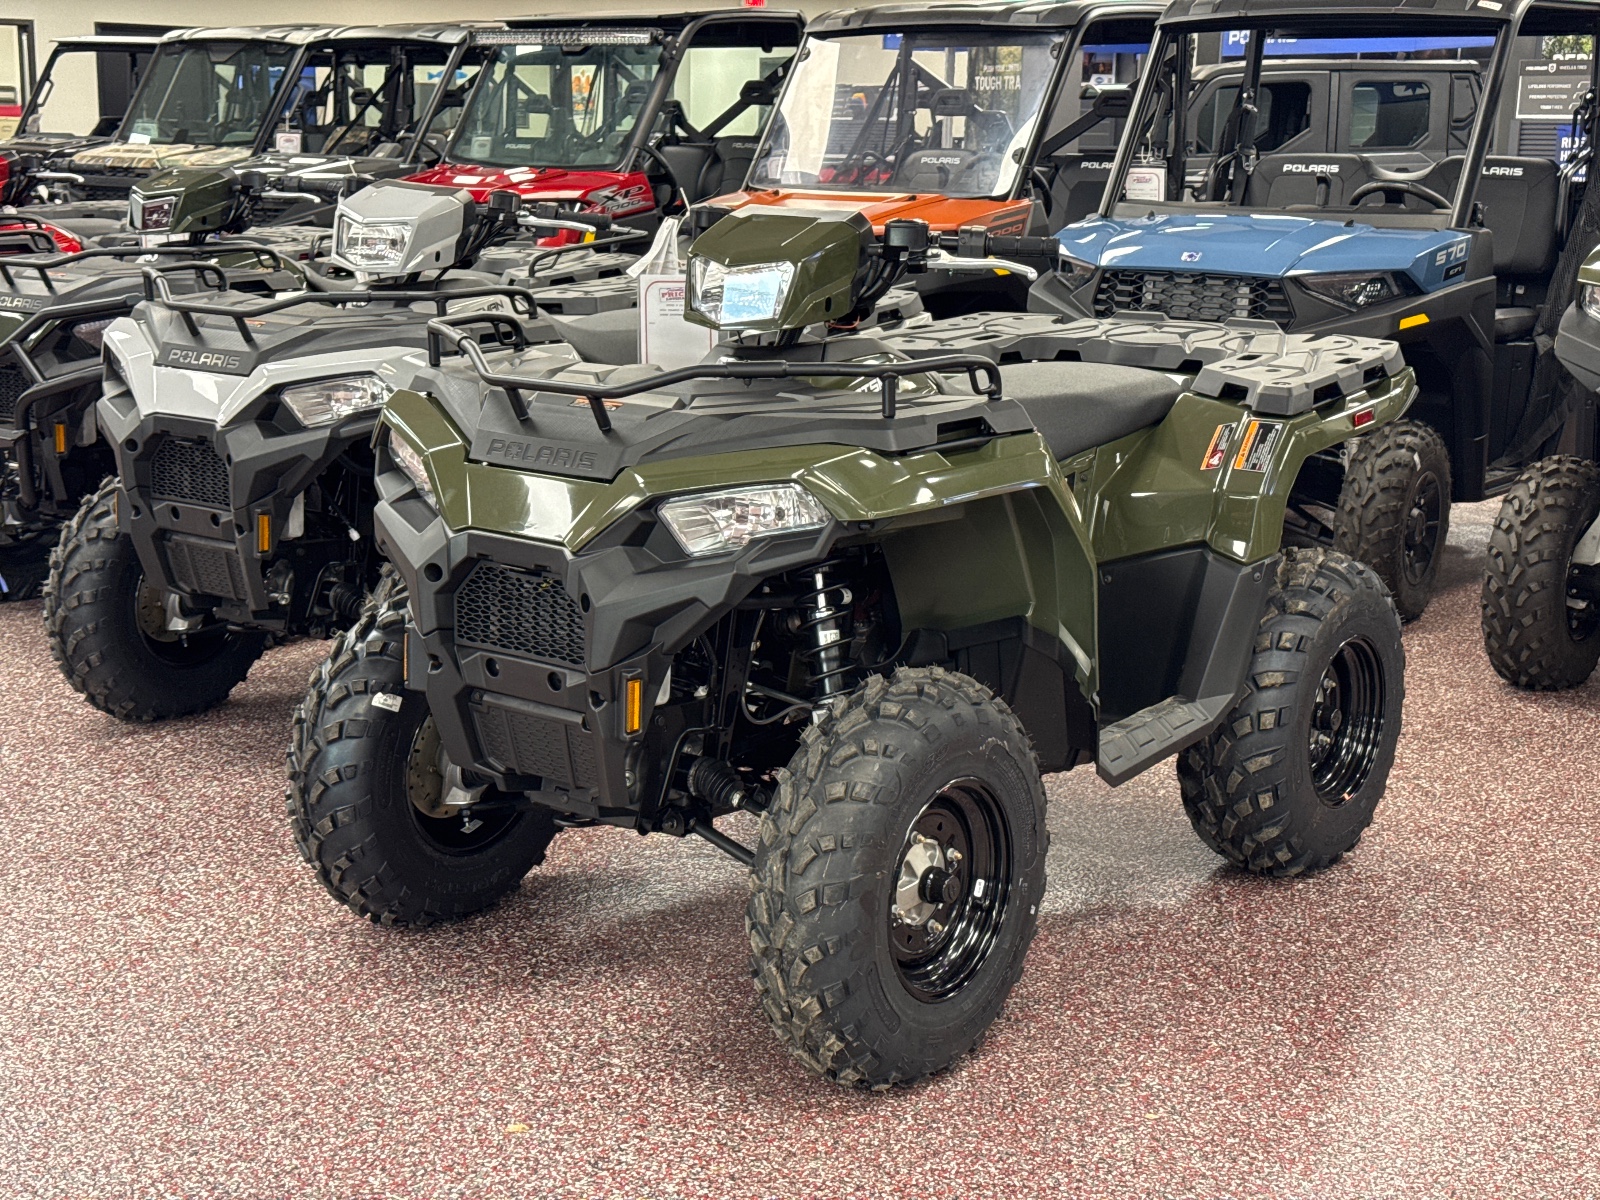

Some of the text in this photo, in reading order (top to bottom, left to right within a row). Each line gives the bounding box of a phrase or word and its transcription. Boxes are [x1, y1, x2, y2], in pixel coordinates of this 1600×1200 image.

[974, 75, 1002, 91] TOUGH
[920, 156, 961, 165] POLARIS
[1282, 163, 1340, 173] POLARIS
[1481, 166, 1524, 176] LARIS
[600, 184, 647, 206] XP
[1435, 242, 1467, 267] 570
[168, 348, 241, 369] POLARIS
[485, 438, 599, 471] POLARIS
